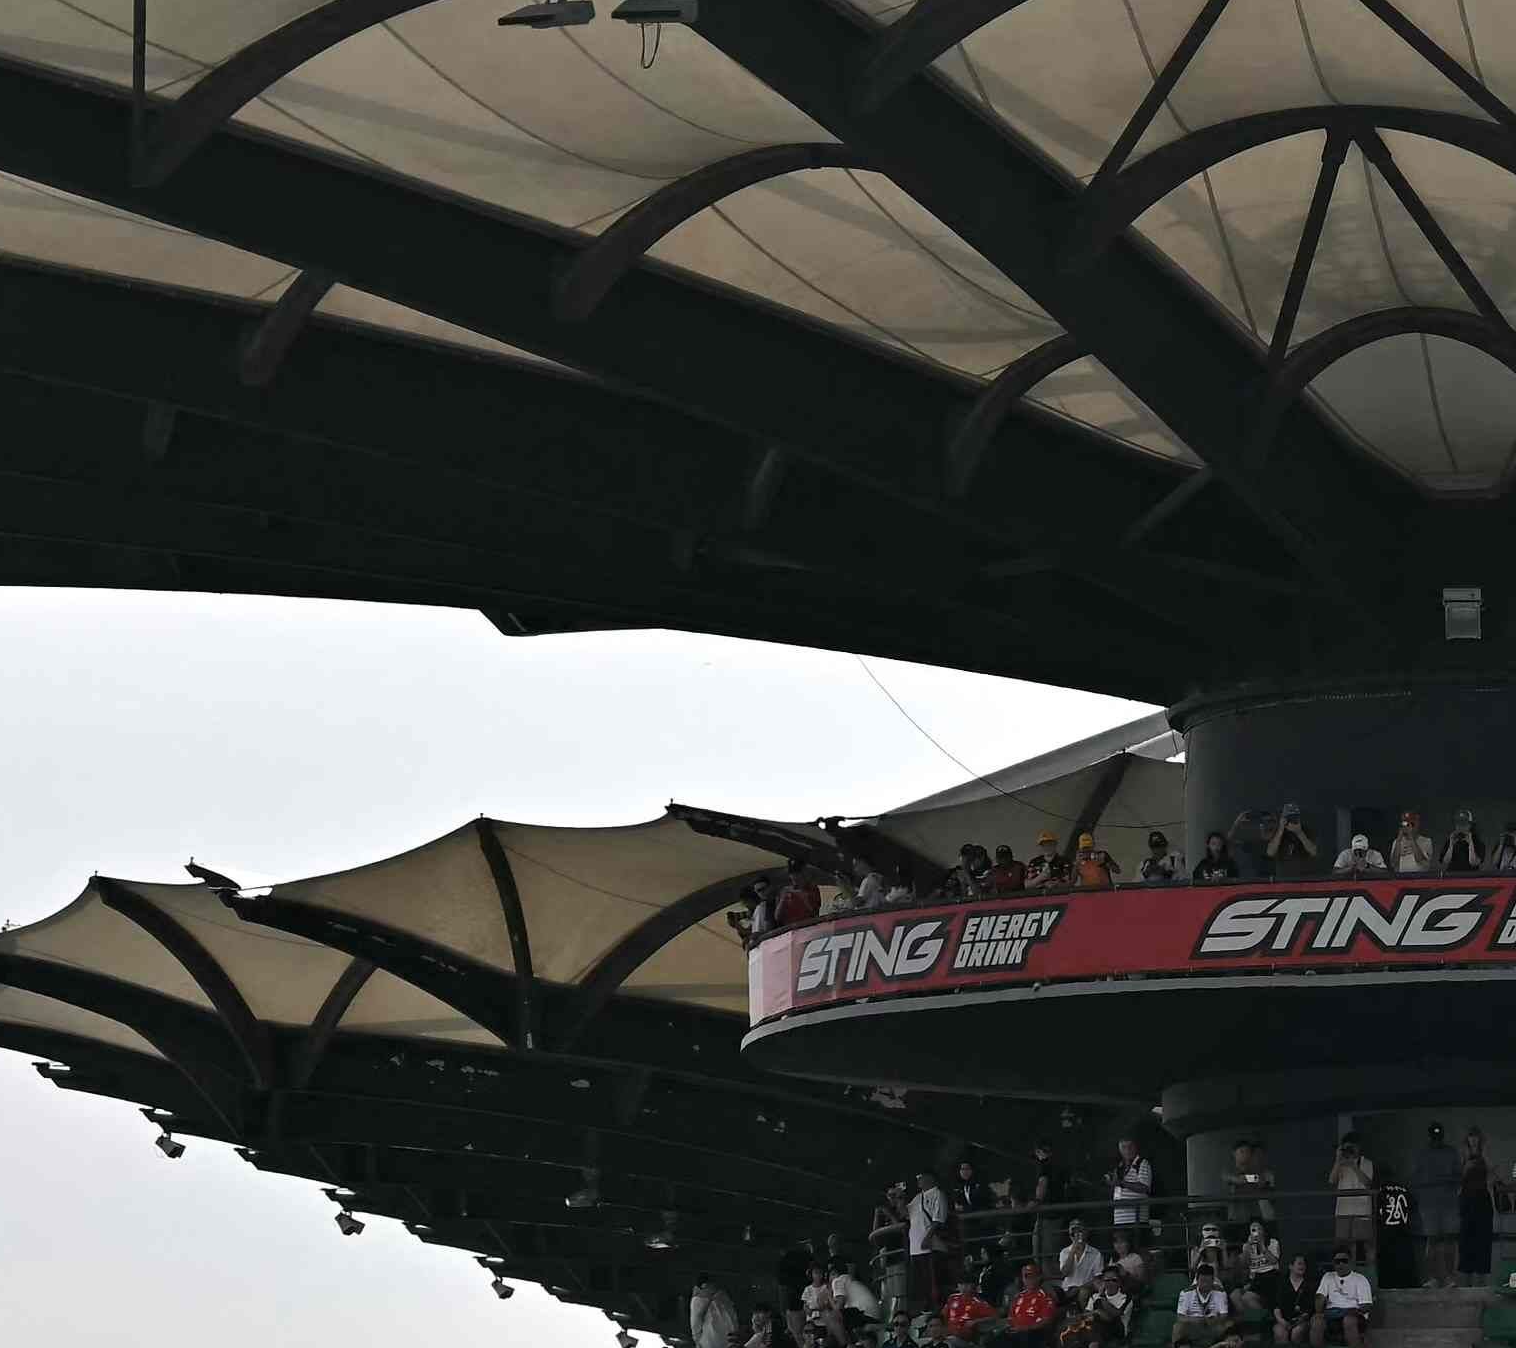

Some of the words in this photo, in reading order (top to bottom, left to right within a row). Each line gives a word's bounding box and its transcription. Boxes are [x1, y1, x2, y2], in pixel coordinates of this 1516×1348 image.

[962, 910, 1060, 942] ENERGY
[1199, 893, 1483, 953] STING
[796, 920, 944, 992] STING
[953, 938, 1029, 969] DRINK
